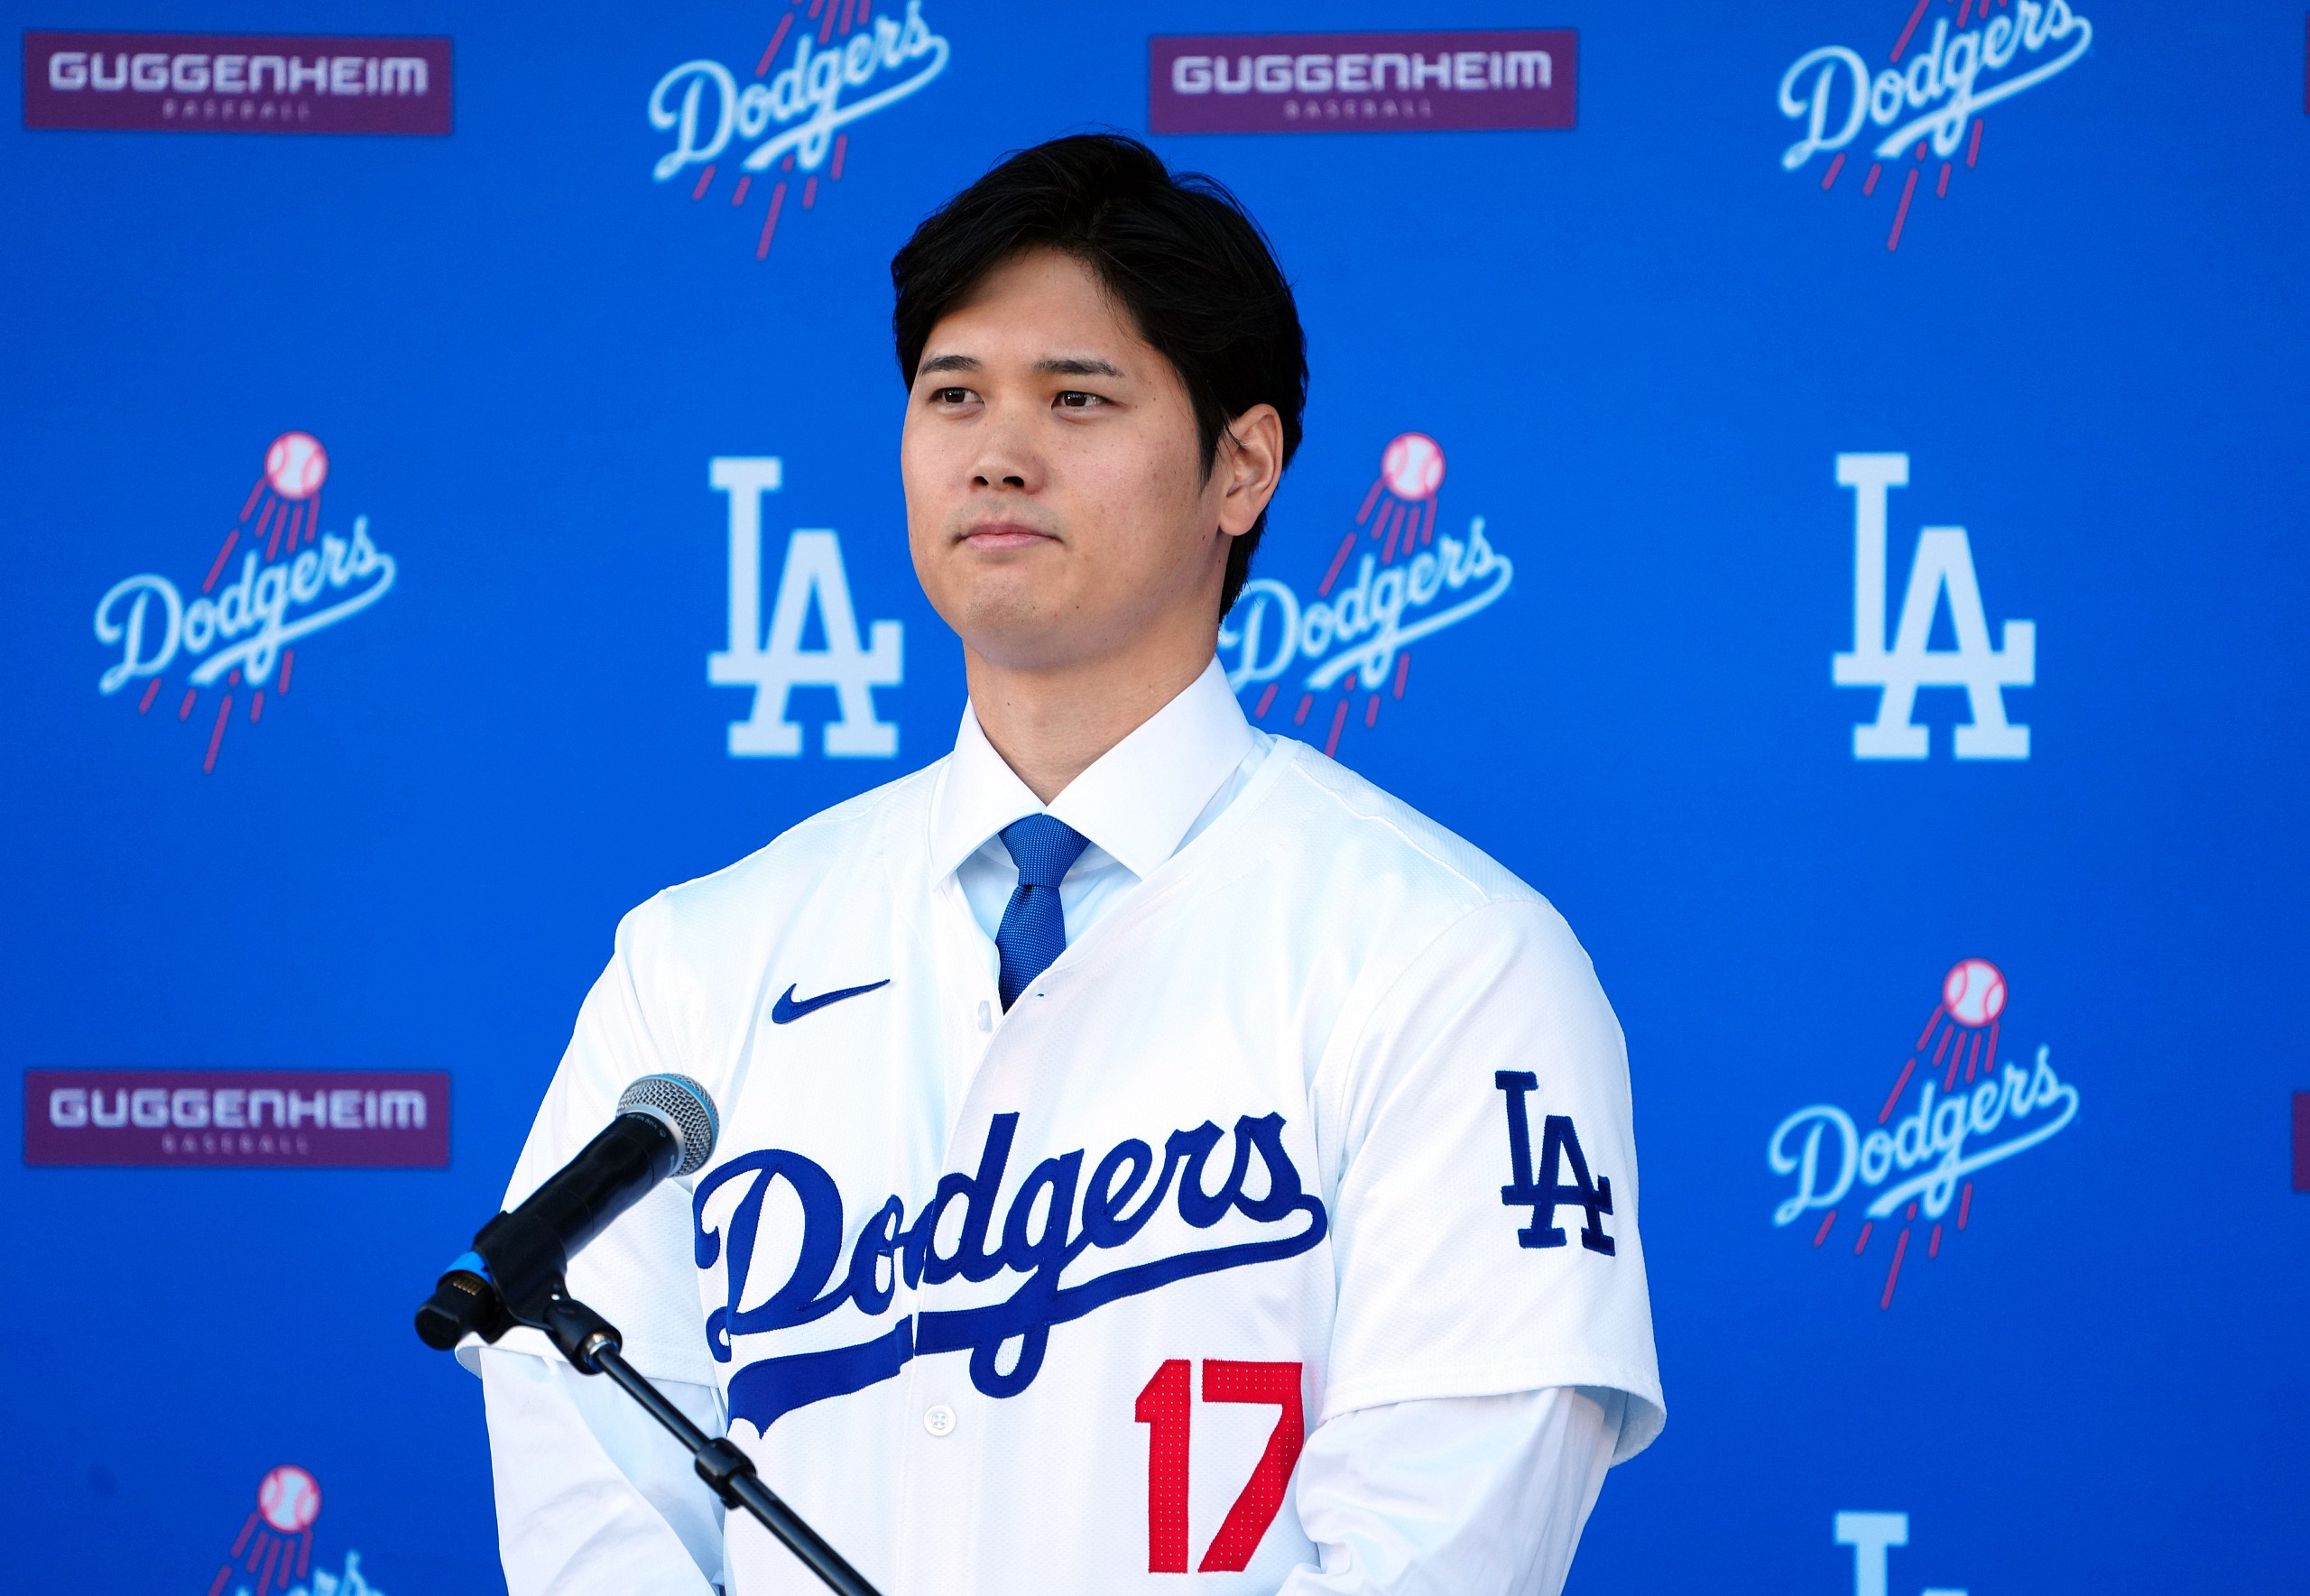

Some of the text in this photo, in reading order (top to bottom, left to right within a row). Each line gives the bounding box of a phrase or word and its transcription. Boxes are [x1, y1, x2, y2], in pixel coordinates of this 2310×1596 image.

[49, 51, 429, 96] GUGGENHEIM
[647, 0, 950, 181] Dodgers
[1172, 50, 1553, 94] GUGGENHEIM
[1778, 0, 2093, 171] Dodgers
[93, 514, 398, 696] Dodgers
[707, 456, 903, 760] LA
[1217, 514, 1514, 696] Dodgers
[1830, 452, 2036, 761] LA
[49, 1088, 427, 1130] GUGGENHEIM
[1495, 1070, 1615, 1257] LA
[1767, 1044, 2079, 1228] Dodgers
[693, 1112, 1328, 1440] Dodgers
[1134, 1358, 1304, 1574] 17
